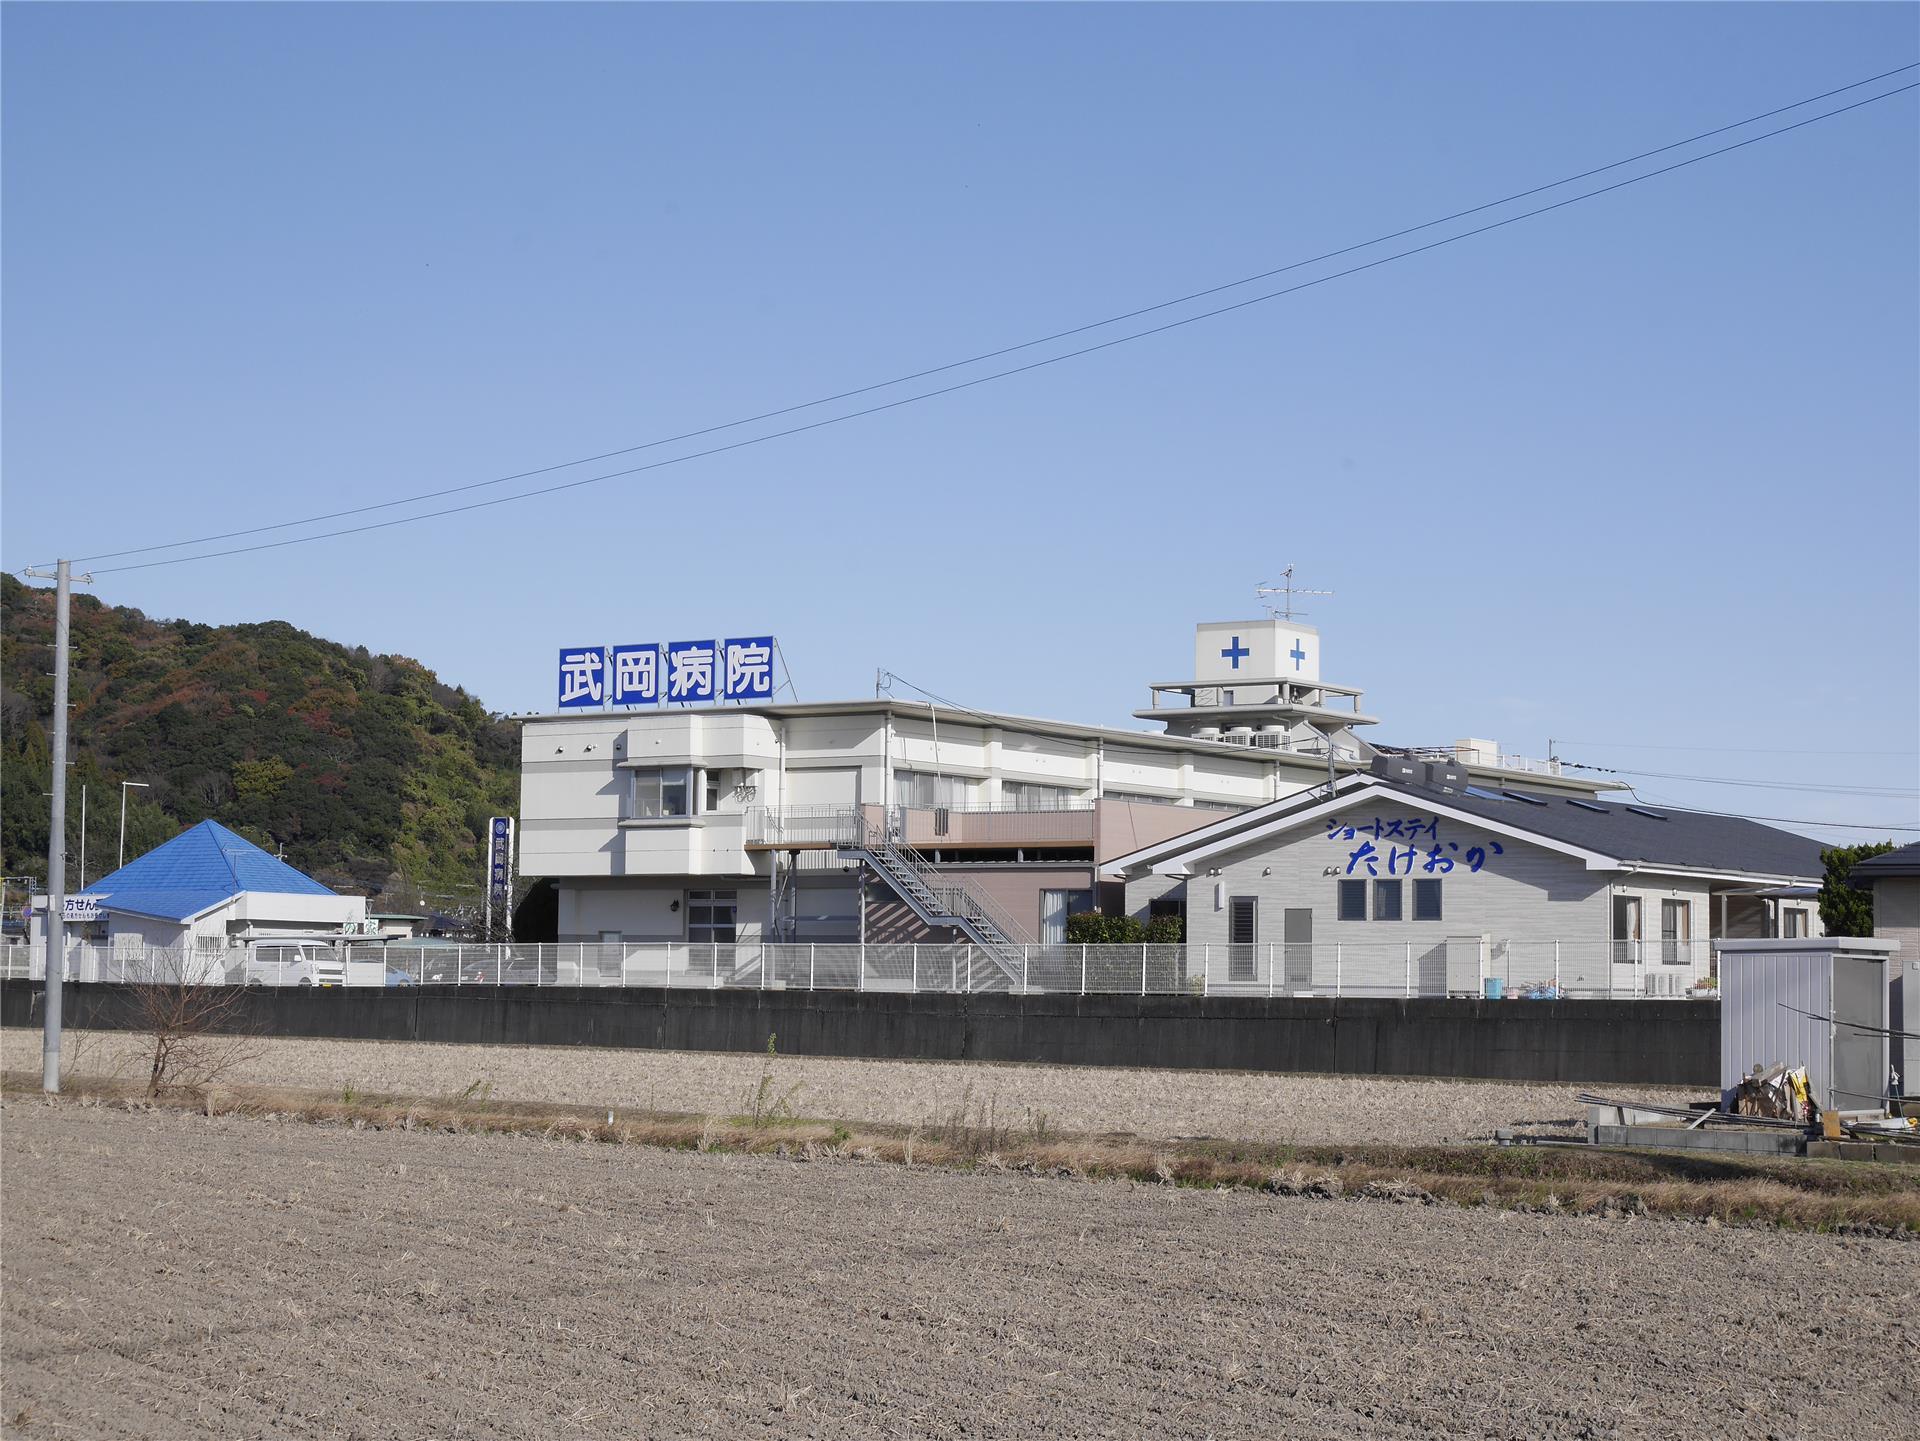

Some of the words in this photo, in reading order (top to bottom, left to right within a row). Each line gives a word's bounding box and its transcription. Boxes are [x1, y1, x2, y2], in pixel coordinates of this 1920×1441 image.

[561, 643, 770, 702] 武岡病院
[1326, 816, 1439, 840] ショートステイ
[1346, 841, 1504, 876] たけおか
[64, 899, 99, 911] 方せん
